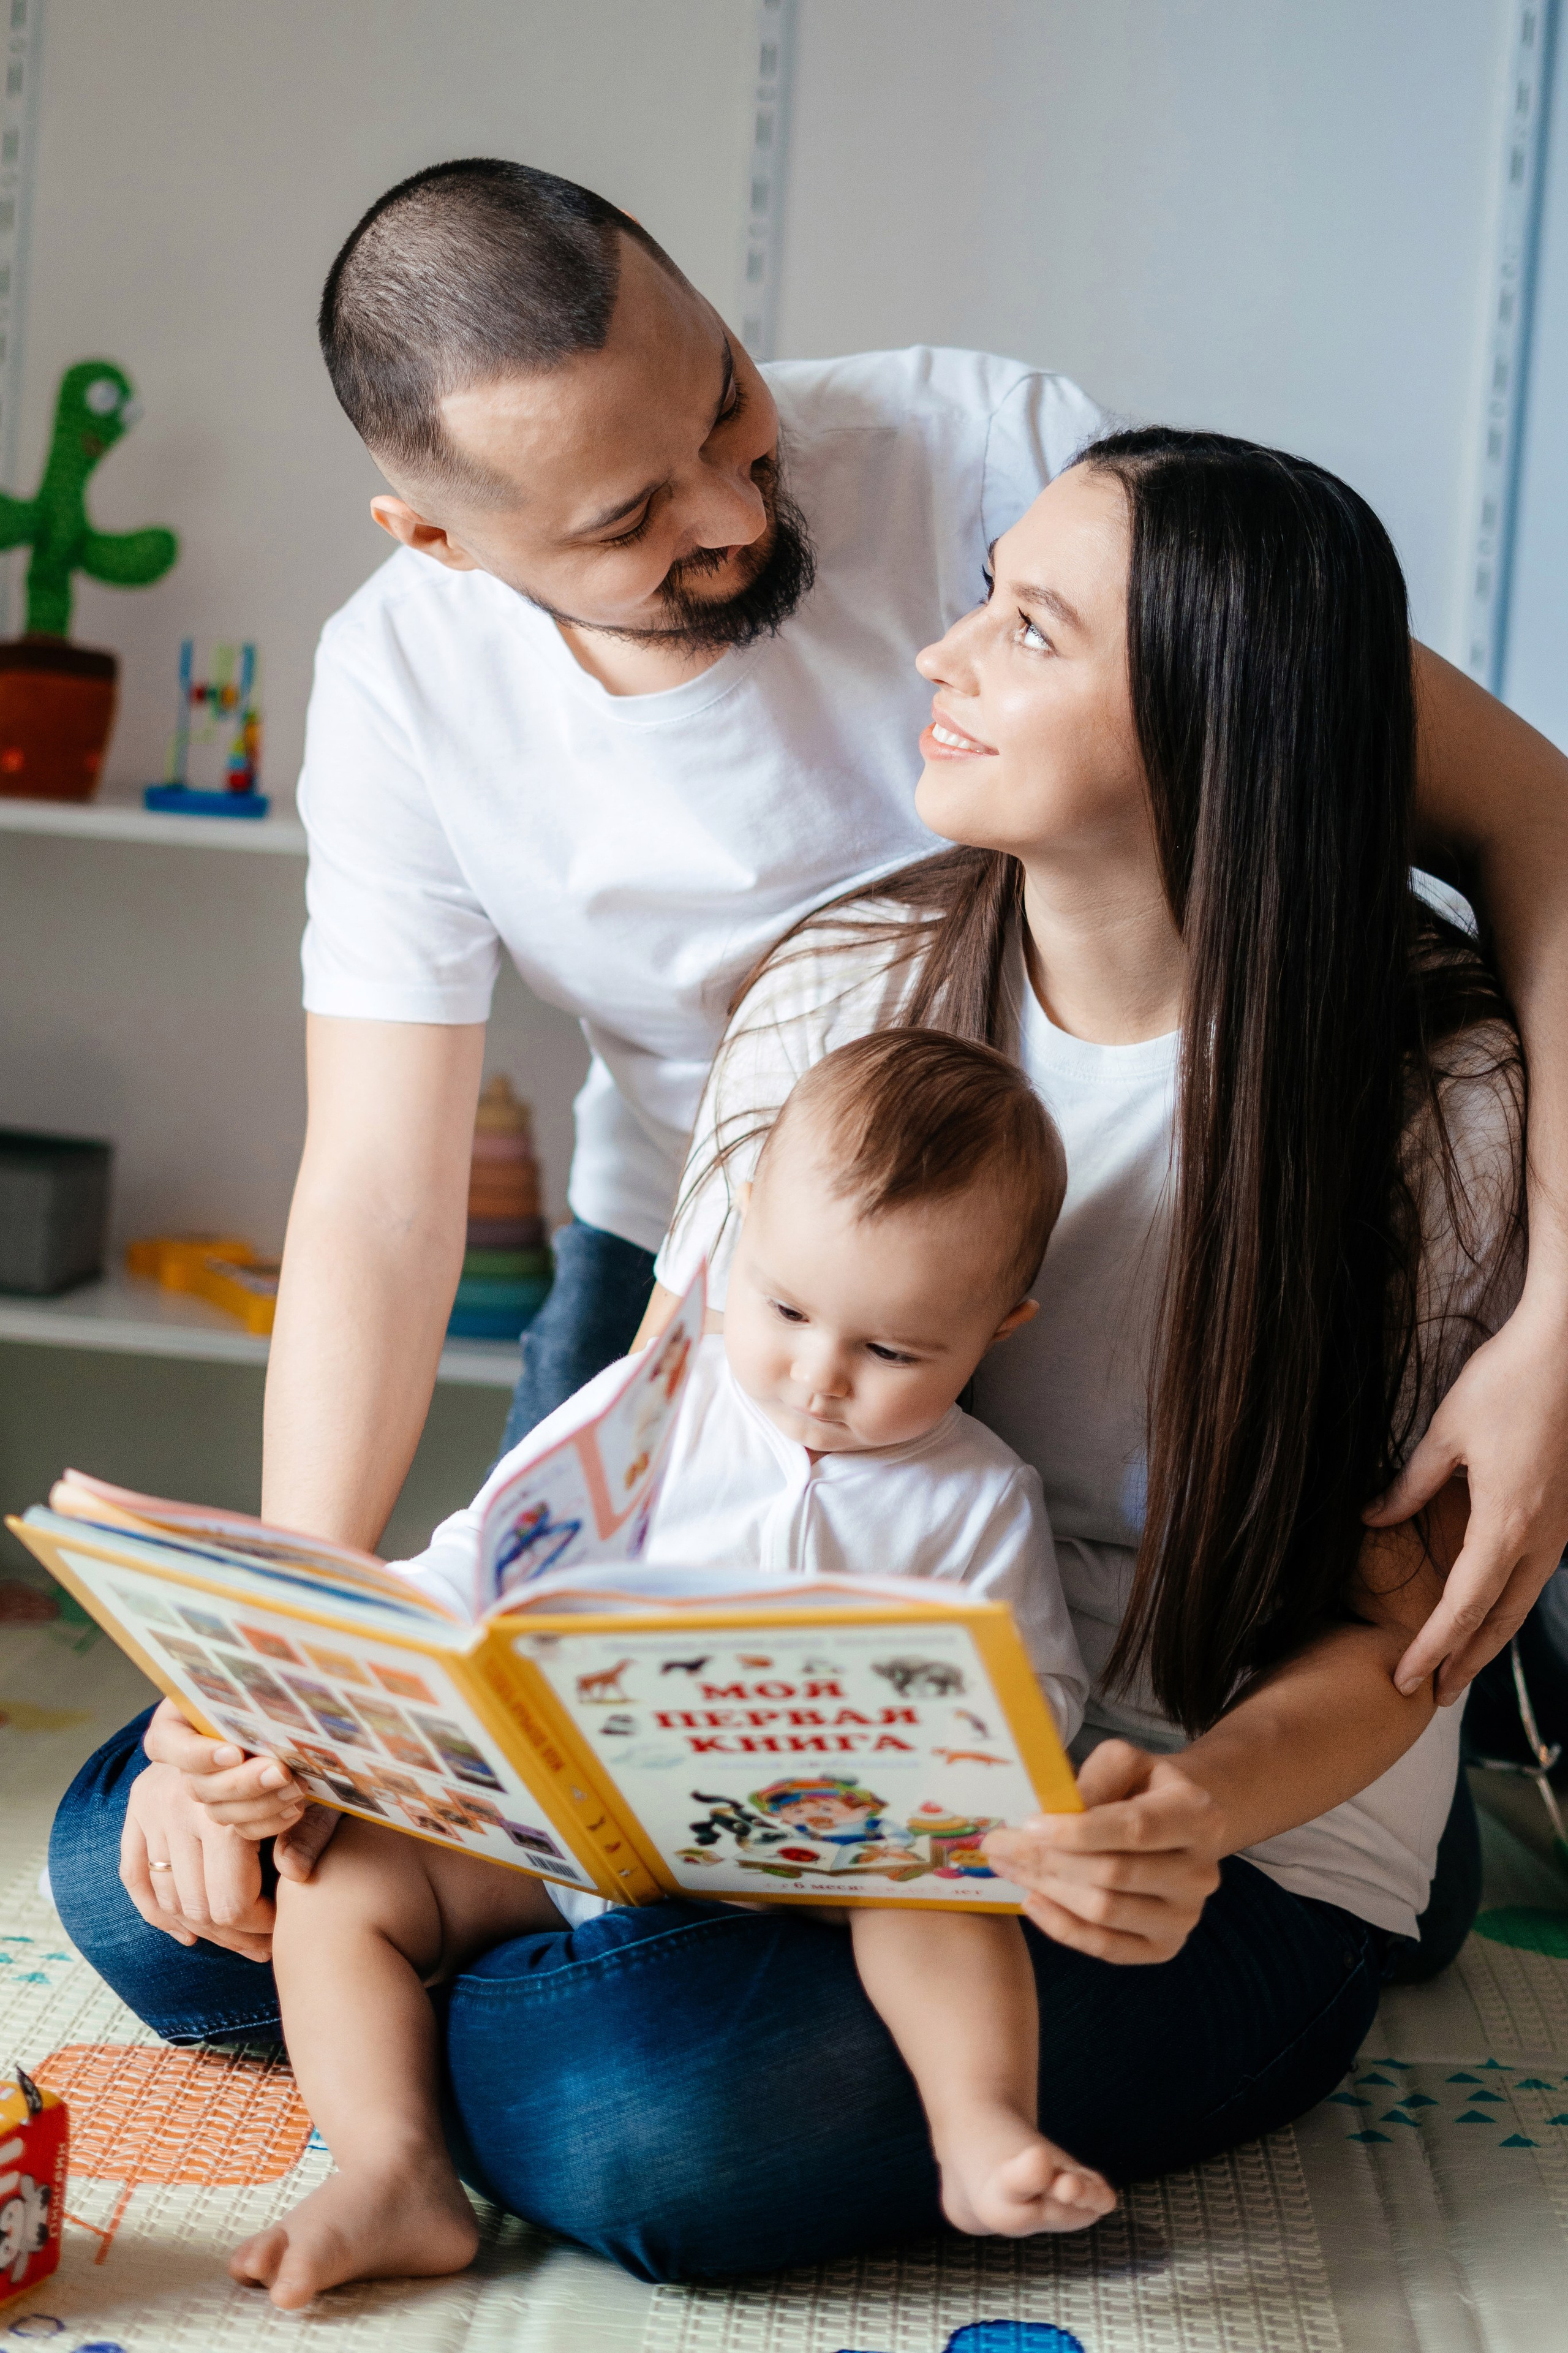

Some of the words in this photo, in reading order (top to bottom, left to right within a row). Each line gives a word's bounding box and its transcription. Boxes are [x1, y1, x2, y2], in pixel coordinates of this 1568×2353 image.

[697, 1680, 846, 1701] МОЯ
[654, 1706, 921, 1729] ПЕРВАЯ
[685, 1733, 916, 1753] КНИГА
